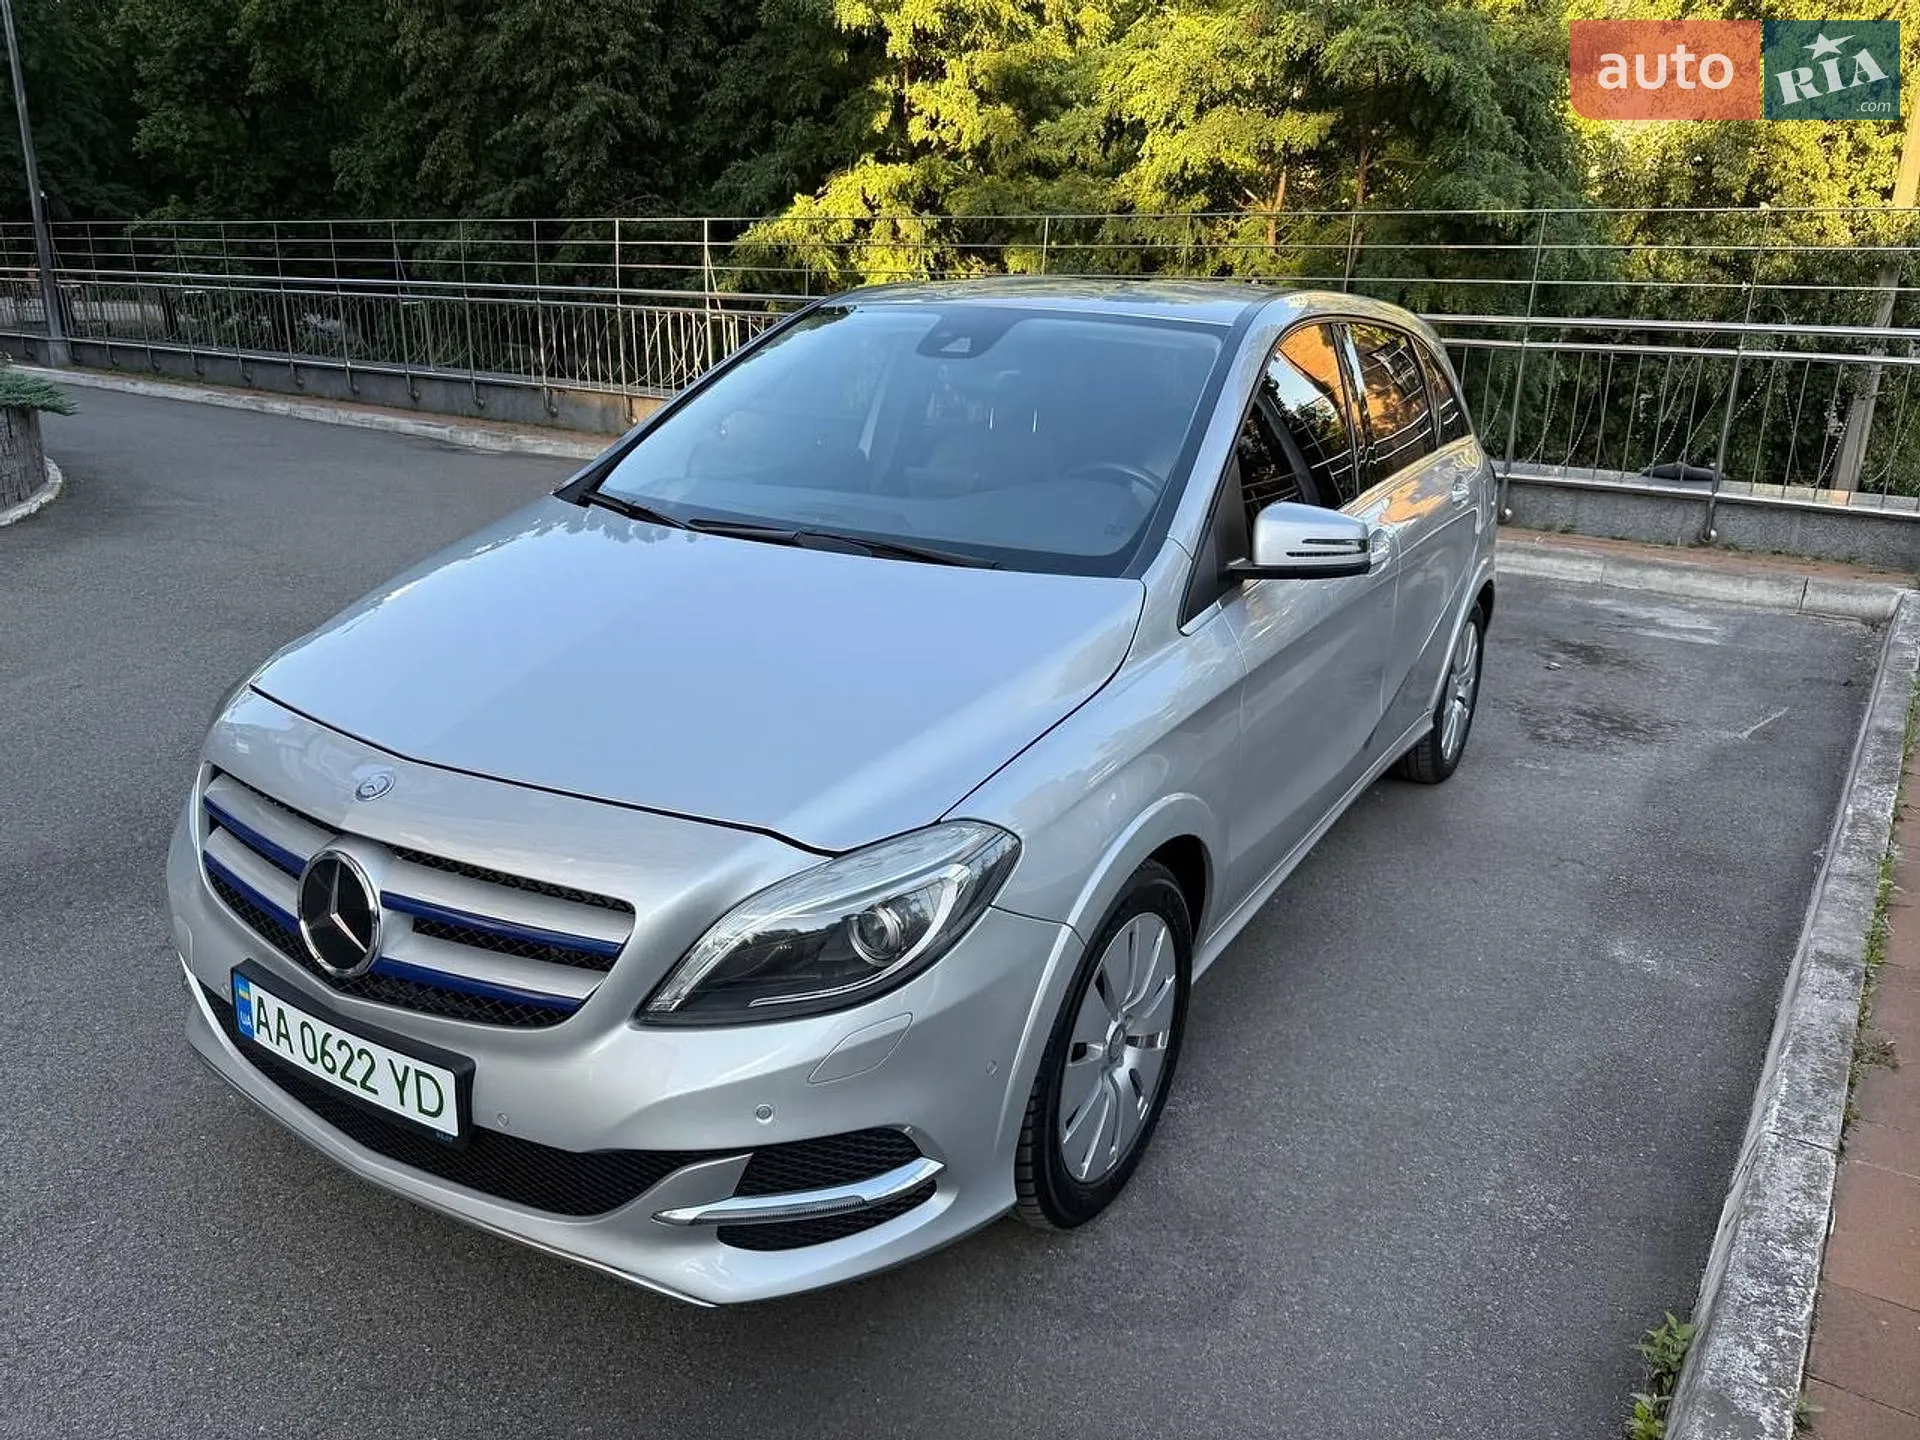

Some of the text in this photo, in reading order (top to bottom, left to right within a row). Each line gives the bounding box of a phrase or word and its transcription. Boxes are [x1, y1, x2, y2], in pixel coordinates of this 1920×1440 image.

[256, 995, 444, 1118] AA 0622 YD
